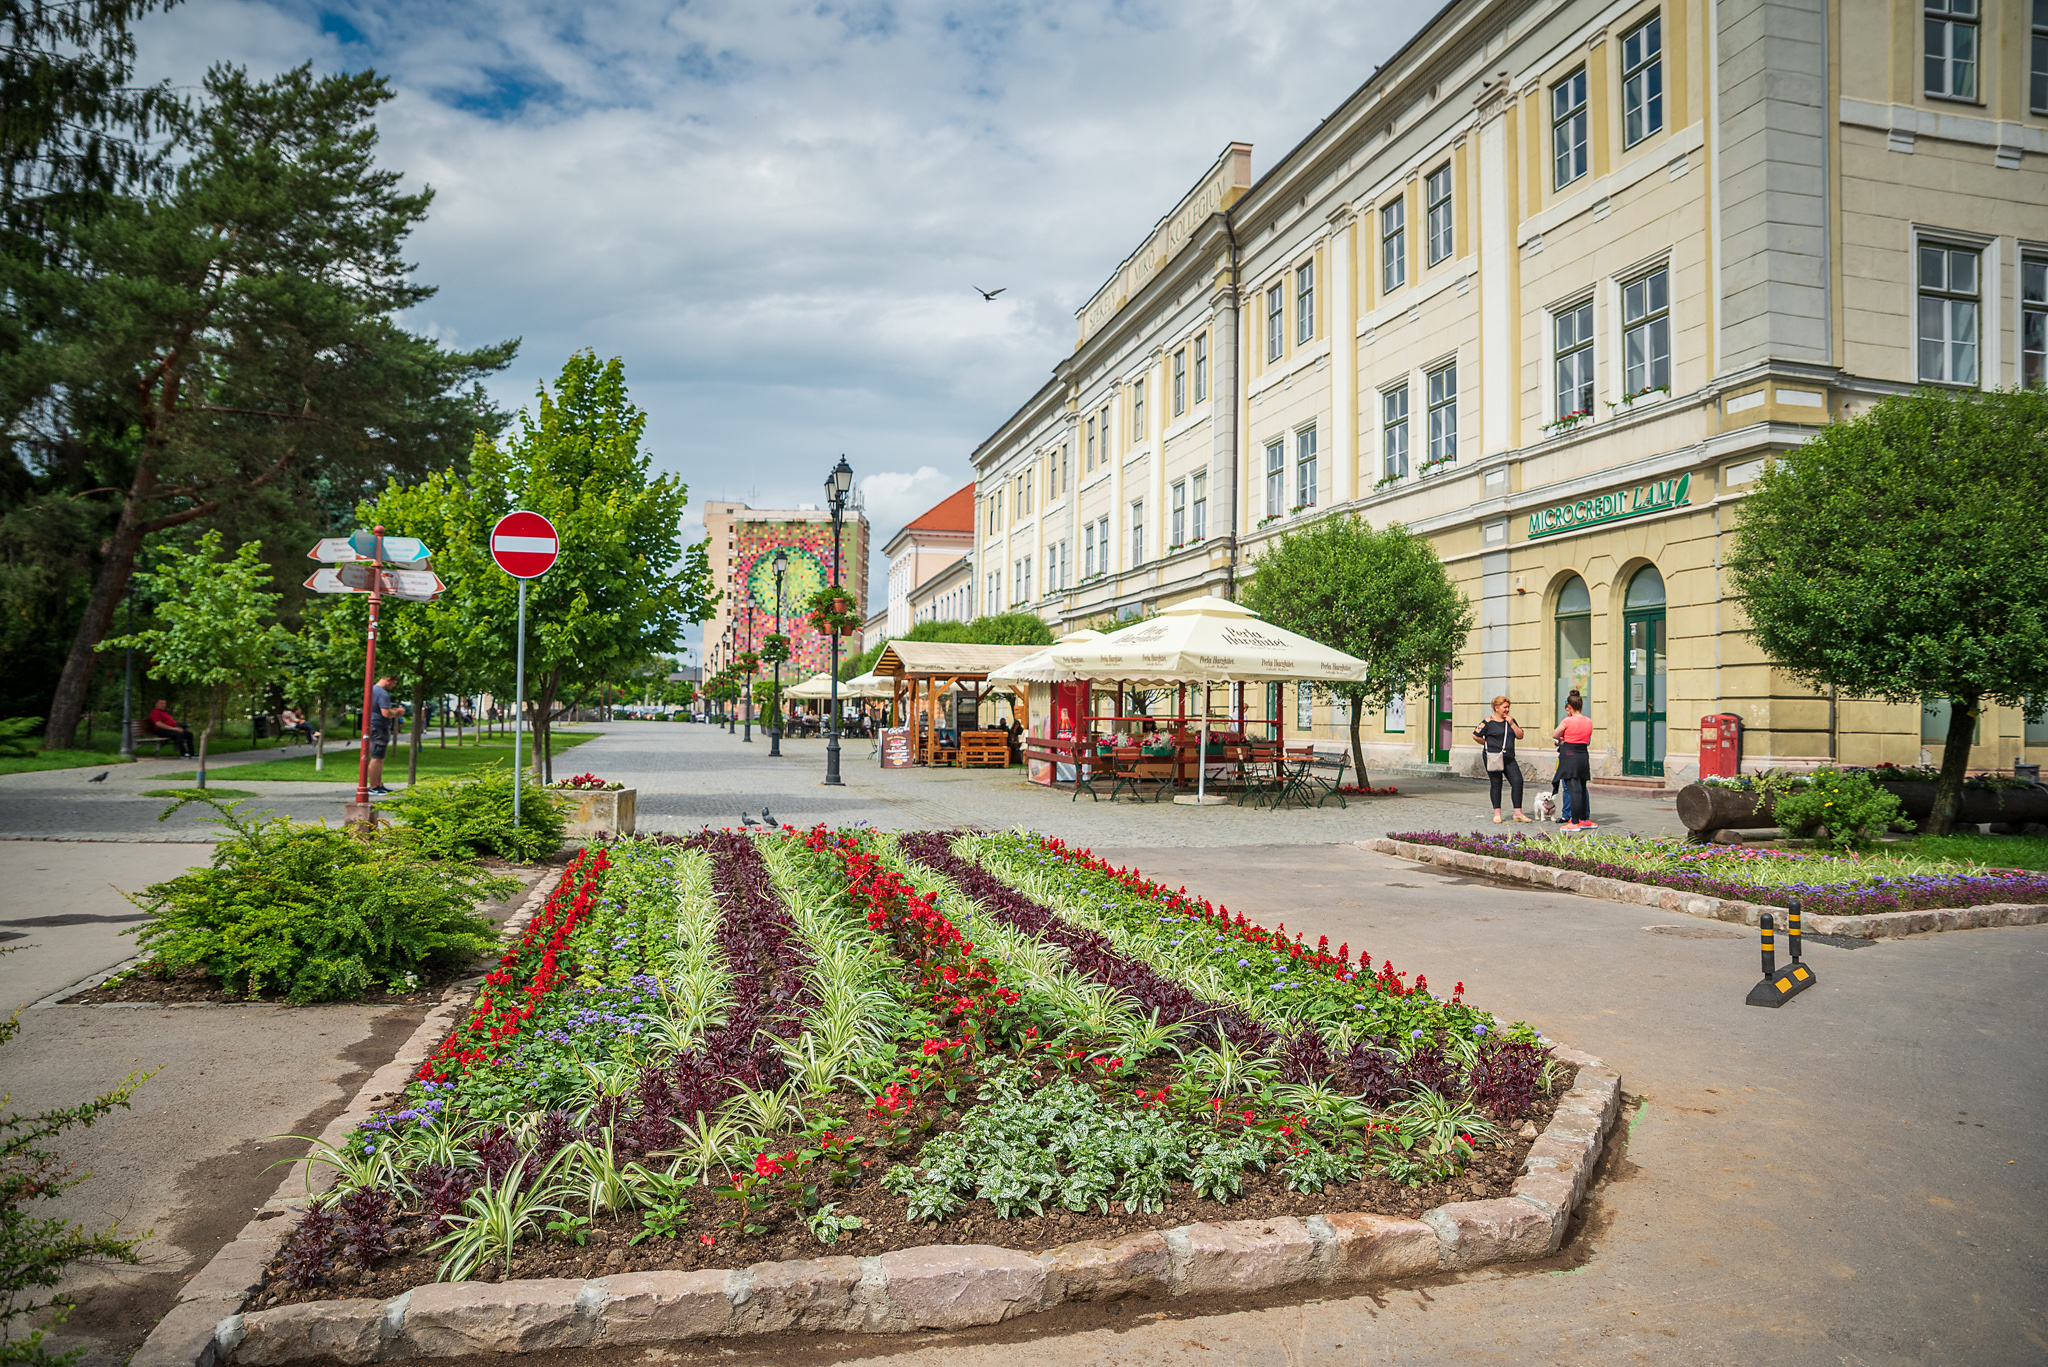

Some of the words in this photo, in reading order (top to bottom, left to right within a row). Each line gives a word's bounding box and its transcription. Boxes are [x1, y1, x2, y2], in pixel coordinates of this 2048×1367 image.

[1133, 244, 1156, 285] MIKÓ
[1528, 490, 1628, 534] MICROCREDIT
[1631, 477, 1678, 511] LAM
[1224, 626, 1265, 639] Perla
